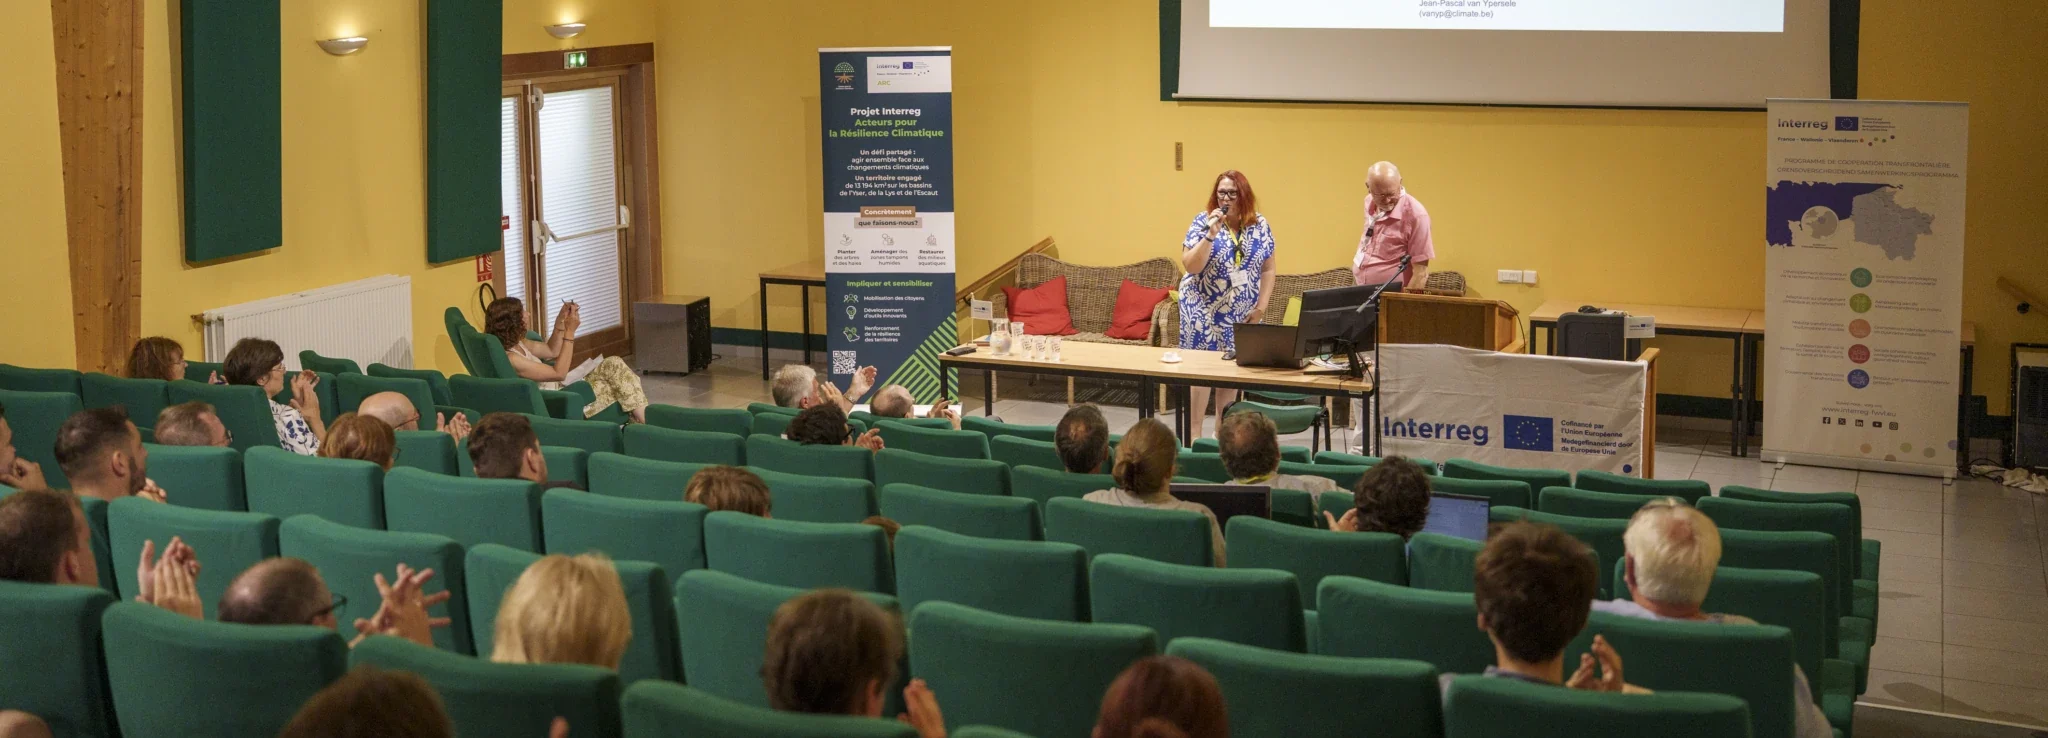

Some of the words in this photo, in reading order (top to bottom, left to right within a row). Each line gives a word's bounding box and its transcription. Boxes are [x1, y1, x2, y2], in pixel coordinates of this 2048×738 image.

[1483, 0, 1516, 8] Ypersele
[1419, 10, 1493, 18] (vanyp@climate.be)
[850, 107, 880, 117] Projet
[882, 107, 921, 117] Interreg
[855, 119, 892, 127] Acteurs
[895, 120, 917, 128] pour
[1778, 118, 1828, 130] Interreg
[829, 129, 838, 138] la
[840, 129, 889, 138] Résilience
[891, 128, 944, 139] Climatique
[871, 148, 885, 156] défi
[886, 149, 913, 157] partagé
[1784, 157, 1826, 165] PROGRAMME
[847, 164, 891, 172] changements
[897, 174, 922, 182] engagé
[884, 190, 896, 198] Lys
[847, 280, 882, 288] Impliquer
[1560, 419, 1593, 428] Cofinancé
[1384, 416, 1489, 446] Interreg
[1560, 427, 1583, 436] l'Union
[1584, 429, 1623, 438] Européenne
[1560, 437, 1617, 447] Medegefinancierd
[1570, 446, 1601, 455] Europese
